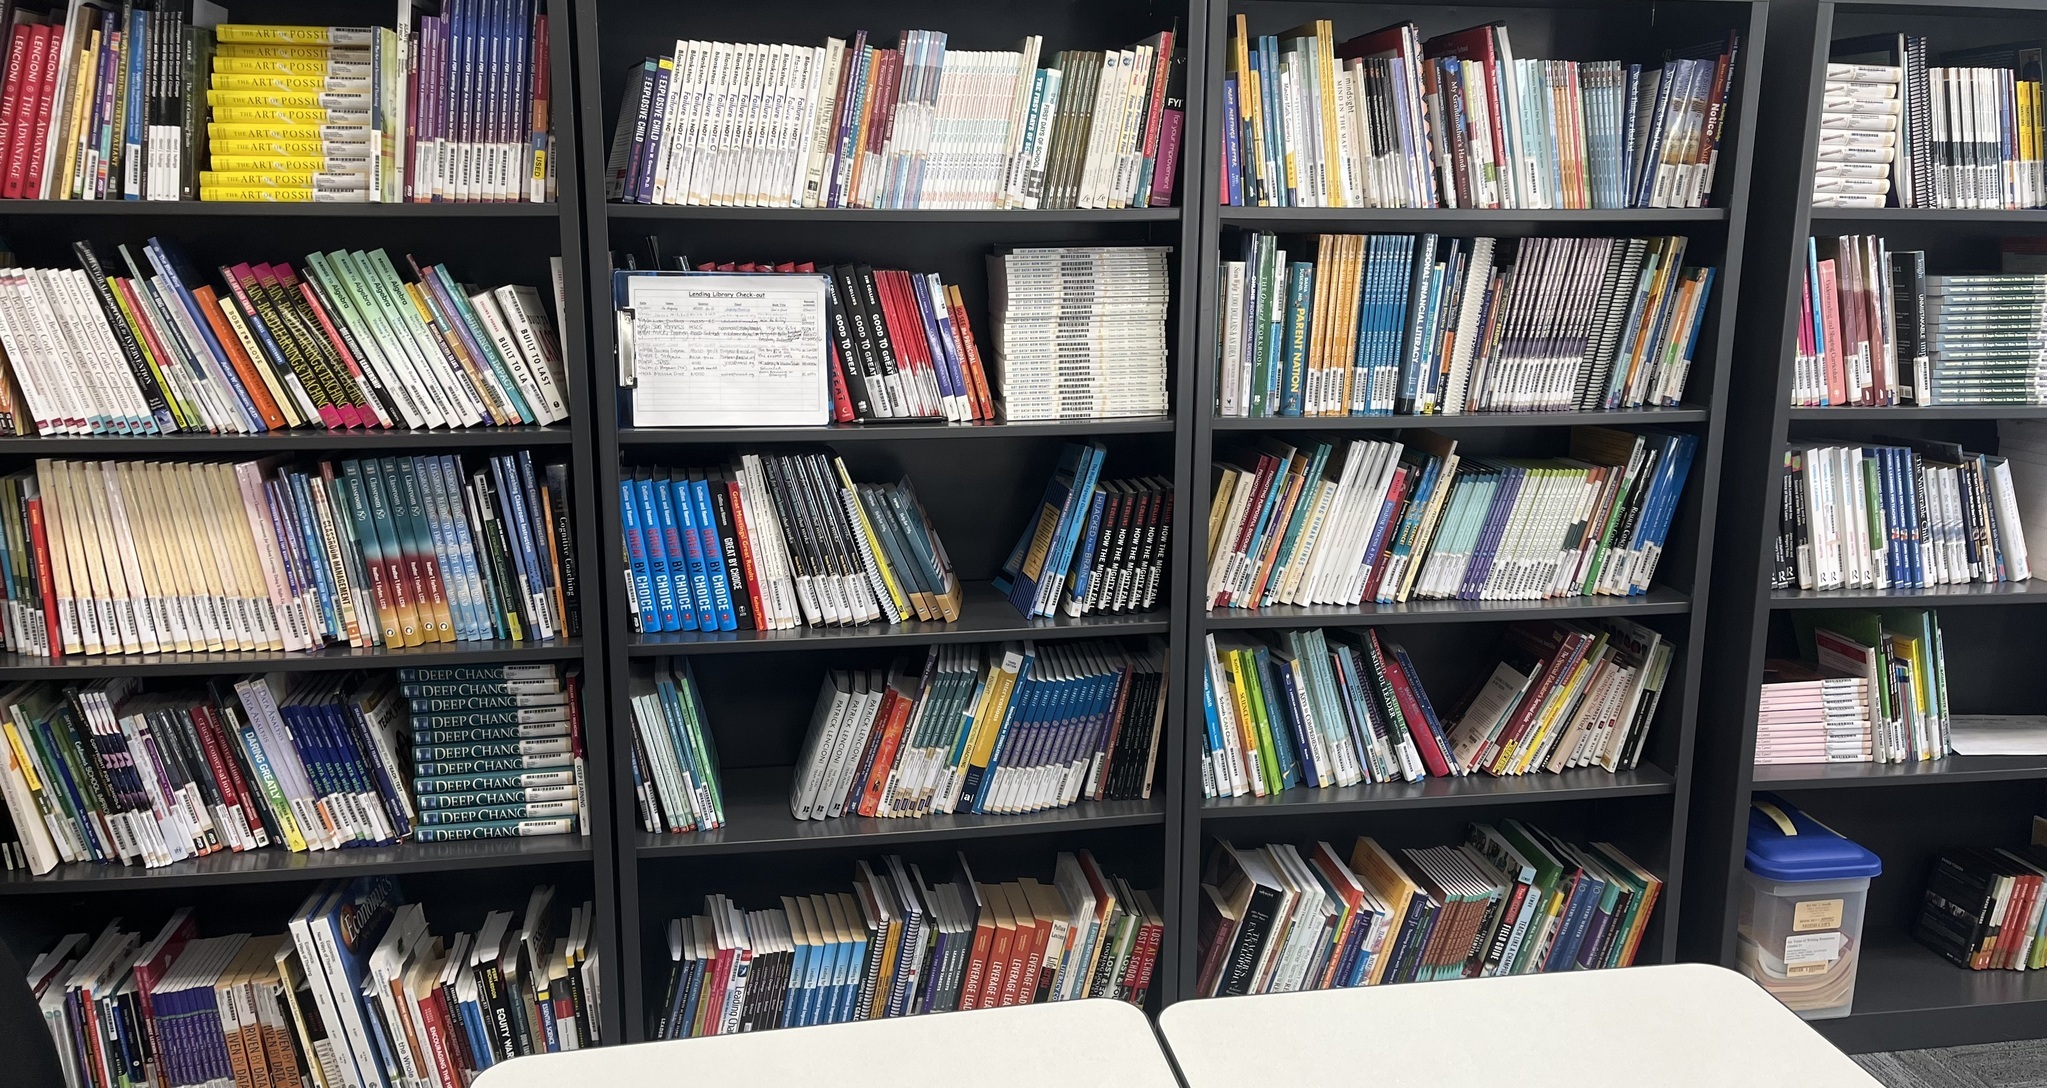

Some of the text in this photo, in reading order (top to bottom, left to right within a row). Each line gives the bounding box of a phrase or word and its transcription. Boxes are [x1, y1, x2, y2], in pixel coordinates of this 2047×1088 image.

[256, 30, 278, 38] ART
[8, 36, 24, 82] LENCIONI
[686, 50, 696, 83] Blankstein
[654, 80, 668, 118] EXPLOSIVE
[668, 50, 684, 119] Blankstein Failure
[1032, 92, 1040, 110] FIRST
[1168, 98, 1182, 107] FYI
[1346, 78, 1354, 113] mindsight
[11, 36, 44, 179] LENCIONI THE ADVANTAGE
[636, 80, 652, 142] EXPLOSIVE CHILD
[681, 92, 691, 119] Failure
[1029, 112, 1037, 131] DAYS
[1707, 103, 1720, 136] Notice
[651, 120, 661, 141] CHILD
[1028, 132, 1033, 140] OF
[1040, 120, 1048, 135] DAYS
[1451, 81, 1466, 171] My Grandmother's Hands
[1033, 144, 1043, 168] SCHOOL
[1163, 114, 1181, 189] for your improvement
[848, 286, 857, 305] COLLINS
[1416, 280, 1429, 321] FINANCIAL
[105, 293, 124, 329] RESPONSE
[125, 336, 151, 384] INTERVENTION
[229, 311, 263, 364] BORN LOVE
[830, 284, 857, 376] COLLINS GOOD TO GREAT
[854, 315, 865, 338] GOOD
[861, 339, 870, 349] TO
[1256, 321, 1265, 367] WORKBOOK
[1411, 322, 1423, 362] LITERACY
[49, 321, 90, 409] Behavior Code Companion
[465, 313, 488, 350] BUILDING
[493, 358, 514, 391] IMPACT
[520, 328, 552, 386] BUILT TO LAST
[865, 351, 876, 376] GREAT
[962, 333, 974, 364] PRINCIPAL
[1291, 309, 1306, 393] PARENT NATION
[351, 479, 362, 509] Classroom
[1917, 477, 1927, 518] Vulnerable
[558, 517, 574, 596] Cognitive Coaching
[628, 529, 642, 558] GREAT
[1081, 496, 1103, 579] HIJACKED BRAIN
[323, 520, 351, 605] CLASSROOM MANAGEMENT
[634, 562, 646, 574] BY
[648, 528, 672, 611] GREAT BY CHOICE
[746, 558, 754, 581] Results
[1089, 530, 1112, 608] HOW THE MIGHTY FALL
[636, 576, 653, 611] CHOICE
[418, 669, 453, 681] DEEP
[1370, 651, 1396, 719] SKILLFUL LEADER
[242, 692, 269, 743] DATA ANALYSIS
[993, 679, 1012, 722] Interventions
[1240, 692, 1250, 717] SCIENCE
[432, 716, 466, 728] DEEP
[819, 700, 843, 764] PATRICK LENCIONI
[1299, 692, 1307, 704] KEYS
[1305, 713, 1322, 763] COMPREHENSION
[198, 718, 232, 799] crucial conversations
[245, 732, 281, 800] DARING GREATLY
[344, 876, 393, 943] Economics
[1125, 927, 1149, 986] LOST AT SCHOOL
[1491, 924, 1511, 961] FIELD GUIDE
[967, 959, 982, 994] LEVERAGE
[1106, 955, 1116, 977] LOST
[496, 1008, 510, 1038] EQUITY
[251, 1055, 268, 1088] BY DATA
[398, 1042, 414, 1079] the Whole
[430, 1026, 450, 1084] ENCOURAGING THE
